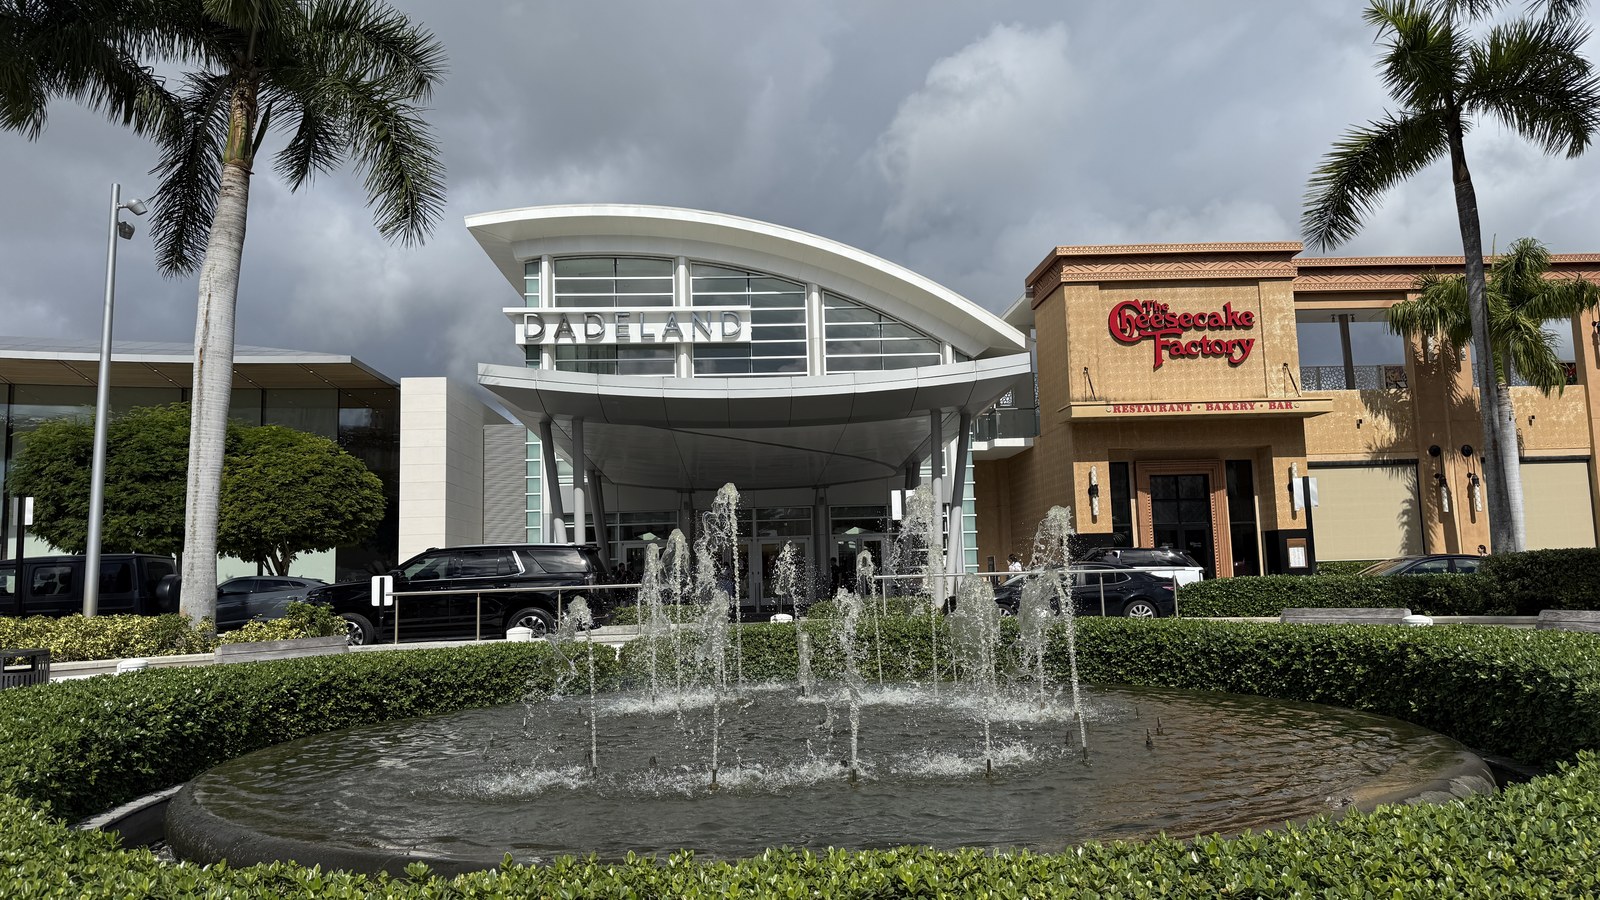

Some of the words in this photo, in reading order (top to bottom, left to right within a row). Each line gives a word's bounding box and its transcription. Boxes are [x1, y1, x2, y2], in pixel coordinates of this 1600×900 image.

[1143, 300, 1169, 312] The
[523, 311, 742, 339] DADELAND
[1108, 299, 1255, 343] Cheesecake
[1140, 328, 1255, 370] Factory
[1113, 403, 1192, 414] RESTAURANT
[1205, 402, 1256, 412] BAKERY
[1268, 401, 1293, 410] BAR
